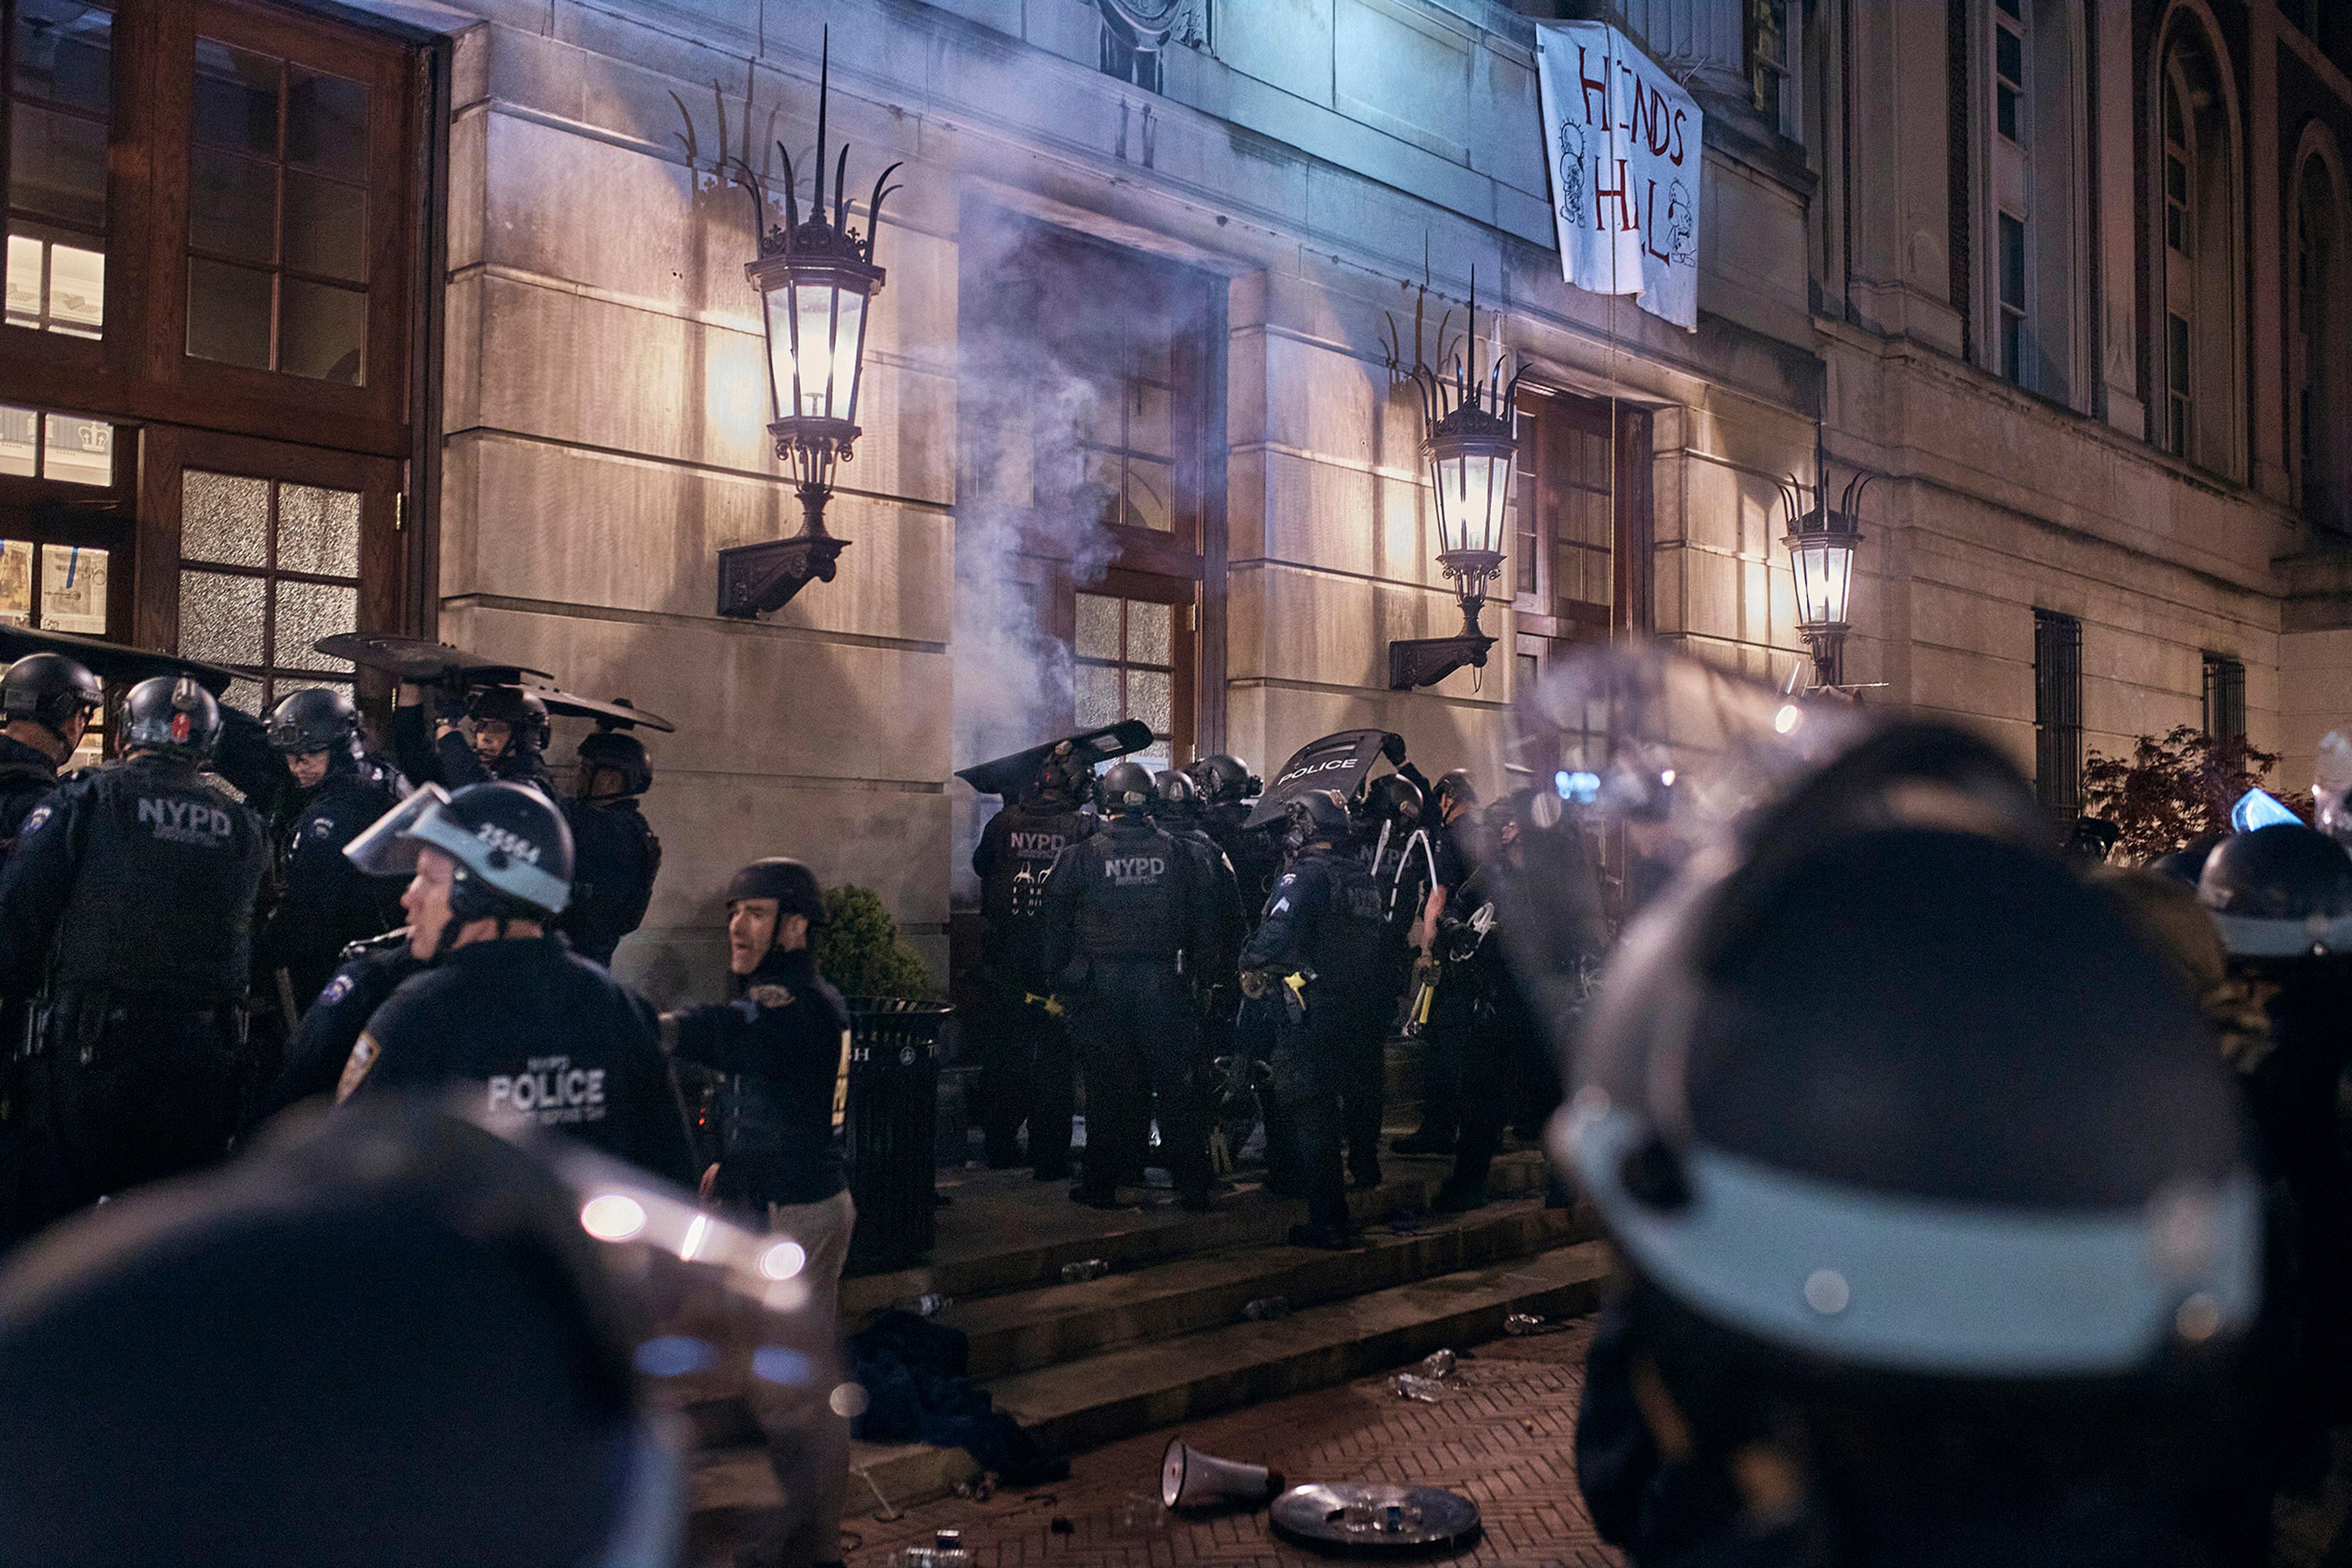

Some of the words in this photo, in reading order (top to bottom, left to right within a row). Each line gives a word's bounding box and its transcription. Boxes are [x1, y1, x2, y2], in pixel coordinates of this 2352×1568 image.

[1578, 46, 1687, 166] HND'S
[1595, 156, 1670, 267] HL
[1278, 759, 1358, 785] POLICE
[138, 797, 232, 835] NYPD
[1011, 832, 1065, 850] NYPD
[1105, 857, 1165, 877] NYPD
[488, 1069, 606, 1111] POLICE
